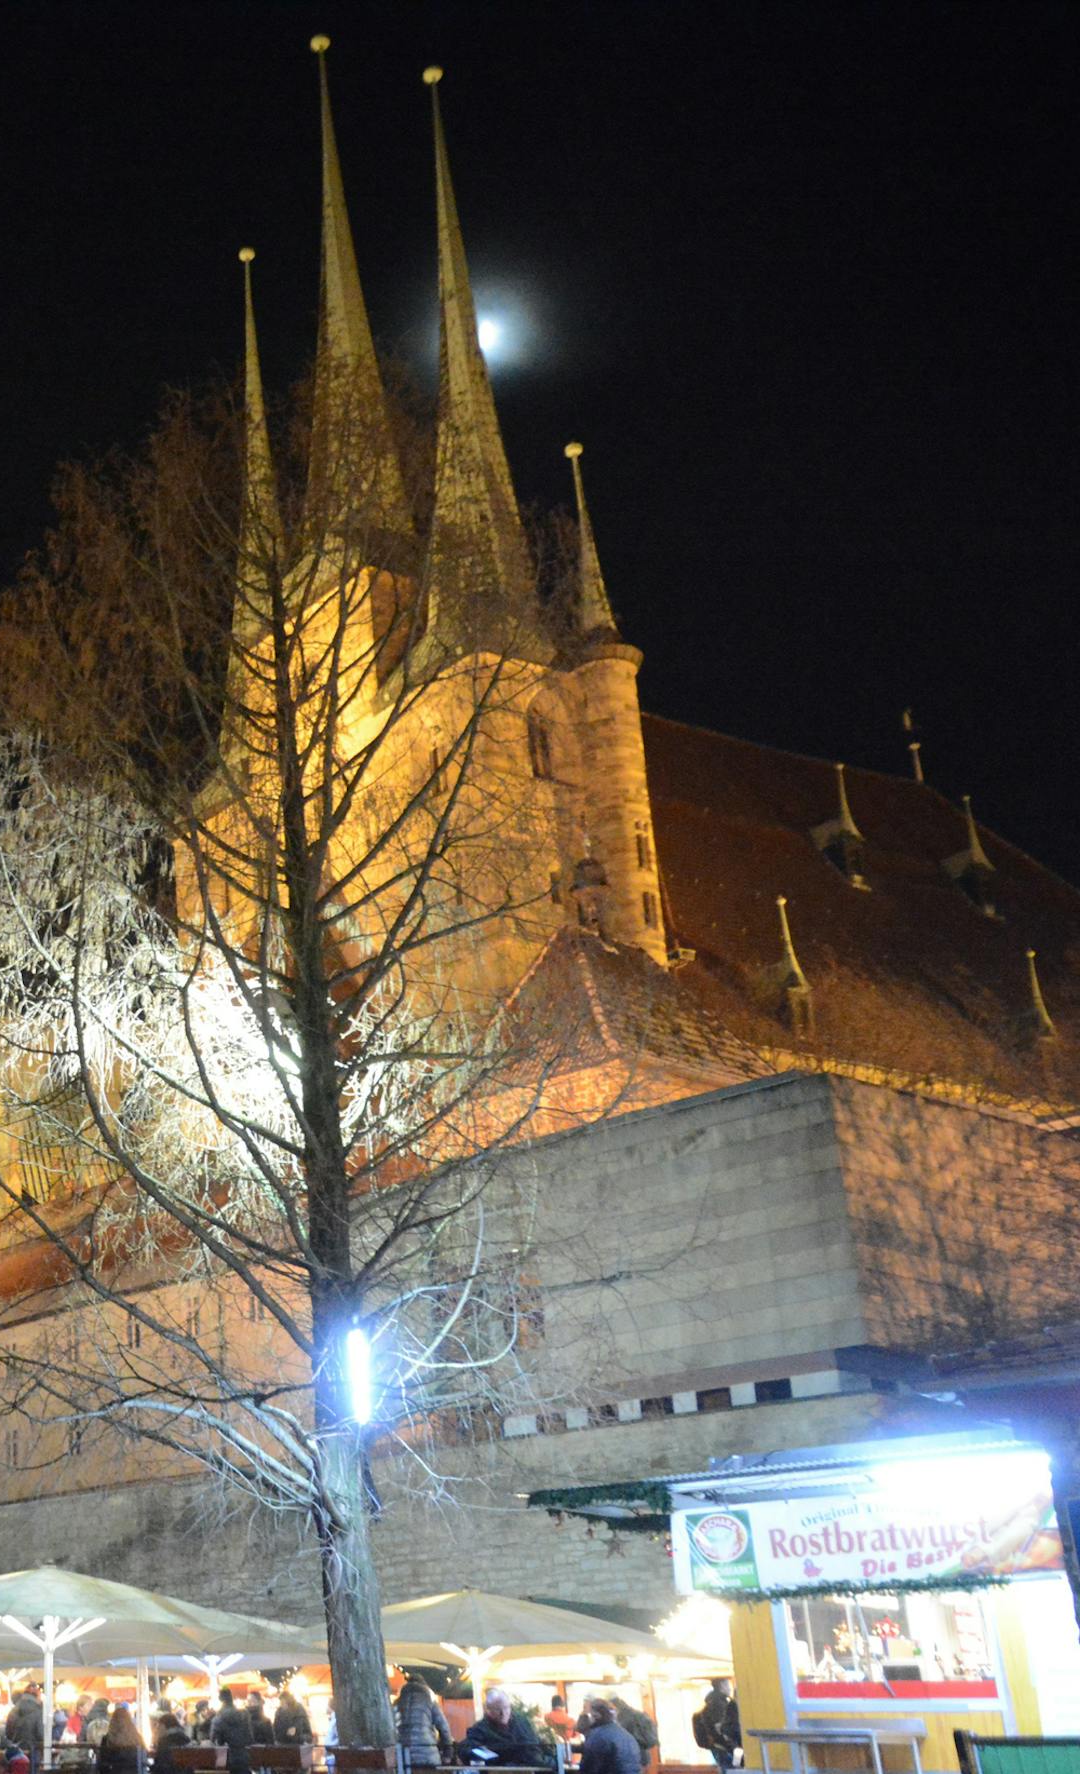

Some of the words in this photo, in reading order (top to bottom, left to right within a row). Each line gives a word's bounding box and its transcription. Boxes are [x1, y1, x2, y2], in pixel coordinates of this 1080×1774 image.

[800, 1503, 860, 1528] Original
[768, 1516, 992, 1559] Rostbratwurst
[860, 1558, 897, 1577] Die
